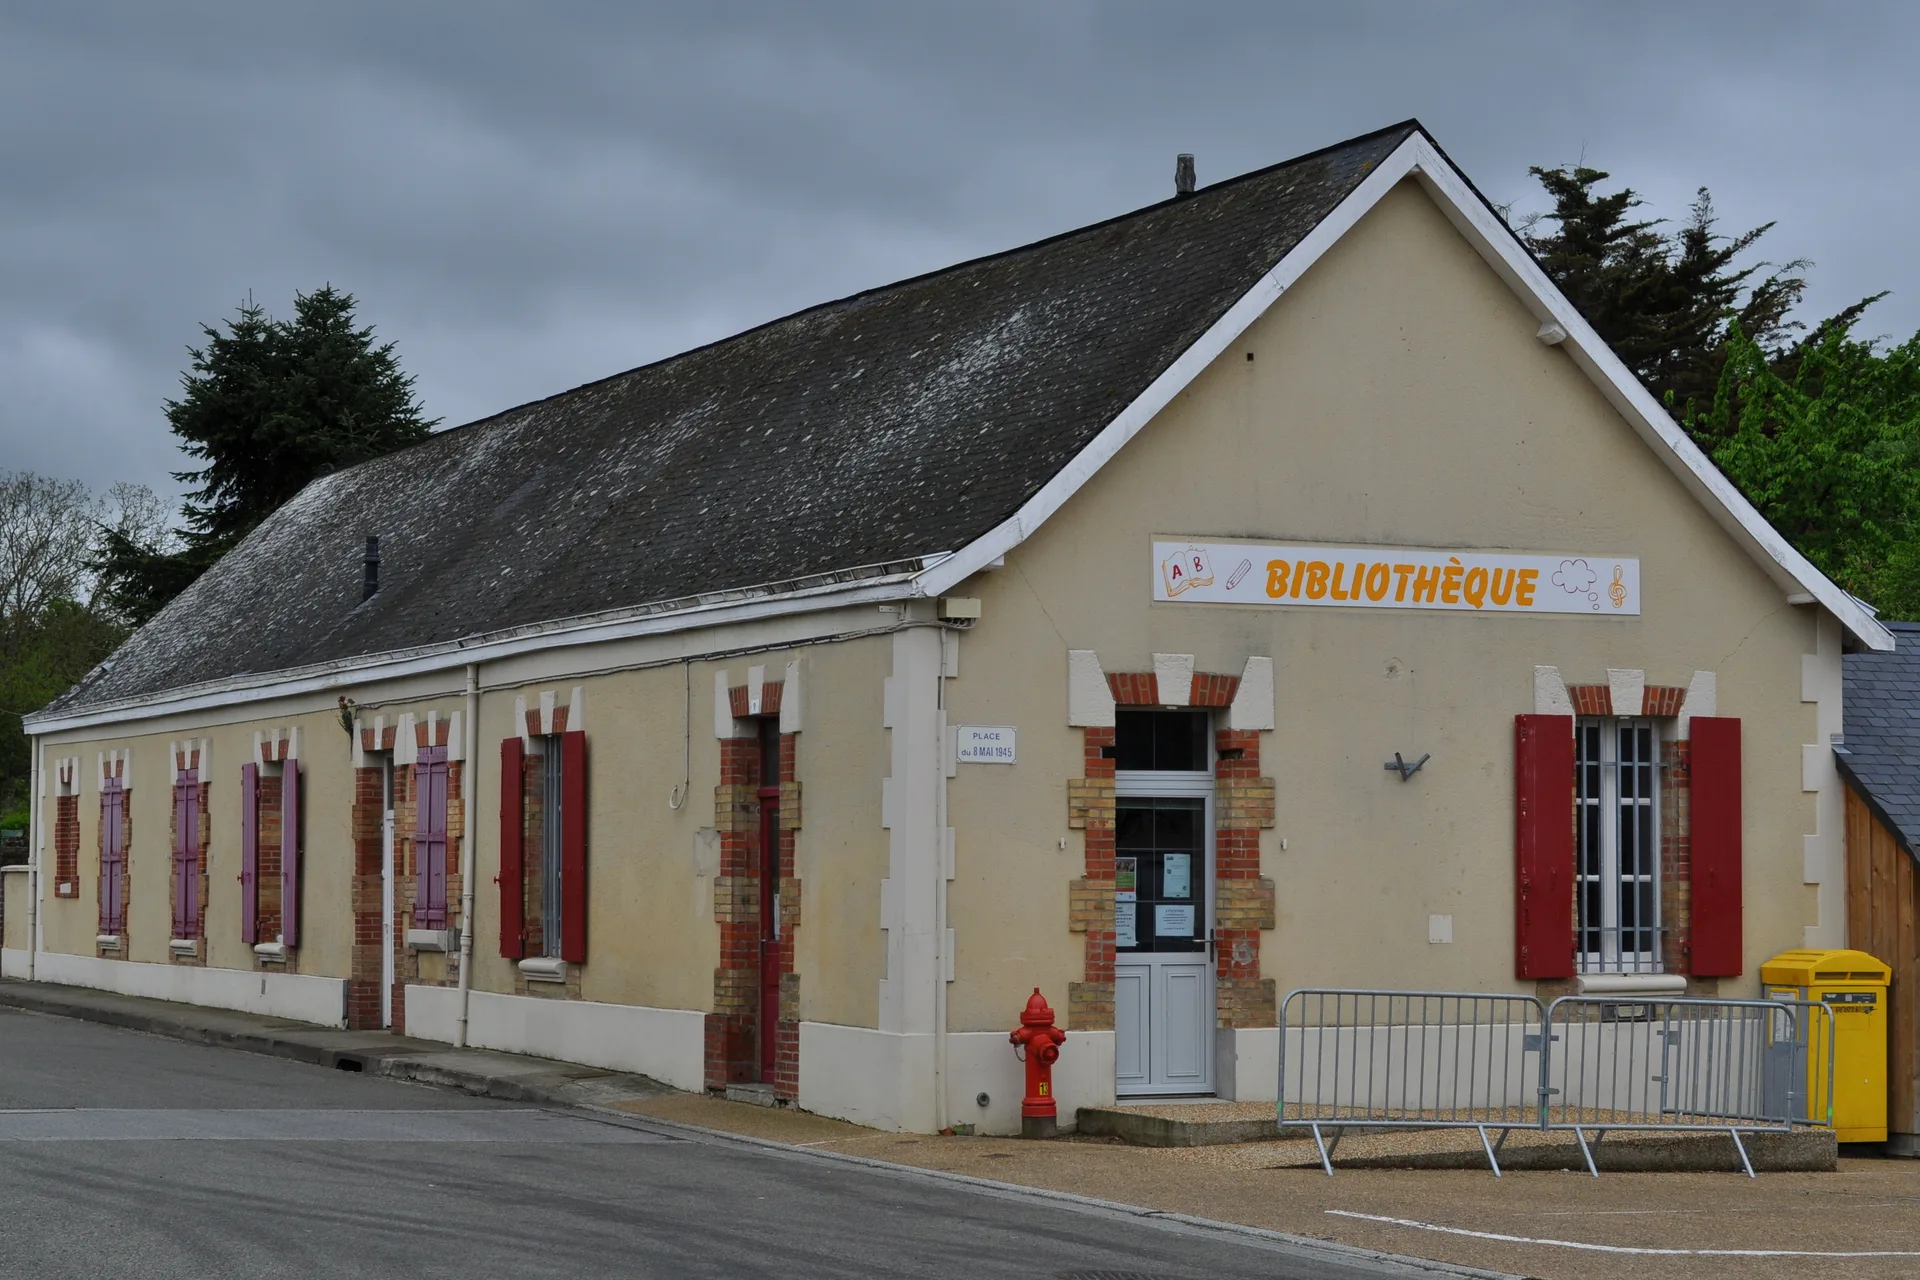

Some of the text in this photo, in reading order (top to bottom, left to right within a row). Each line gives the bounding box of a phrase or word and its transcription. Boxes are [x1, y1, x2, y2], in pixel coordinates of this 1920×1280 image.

[1171, 556, 1204, 580] A B
[1265, 557, 1539, 610] BIBLIOTHÈQUE
[972, 732, 1001, 740] PLACE
[961, 746, 1012, 757] du 8 MAI 1945
